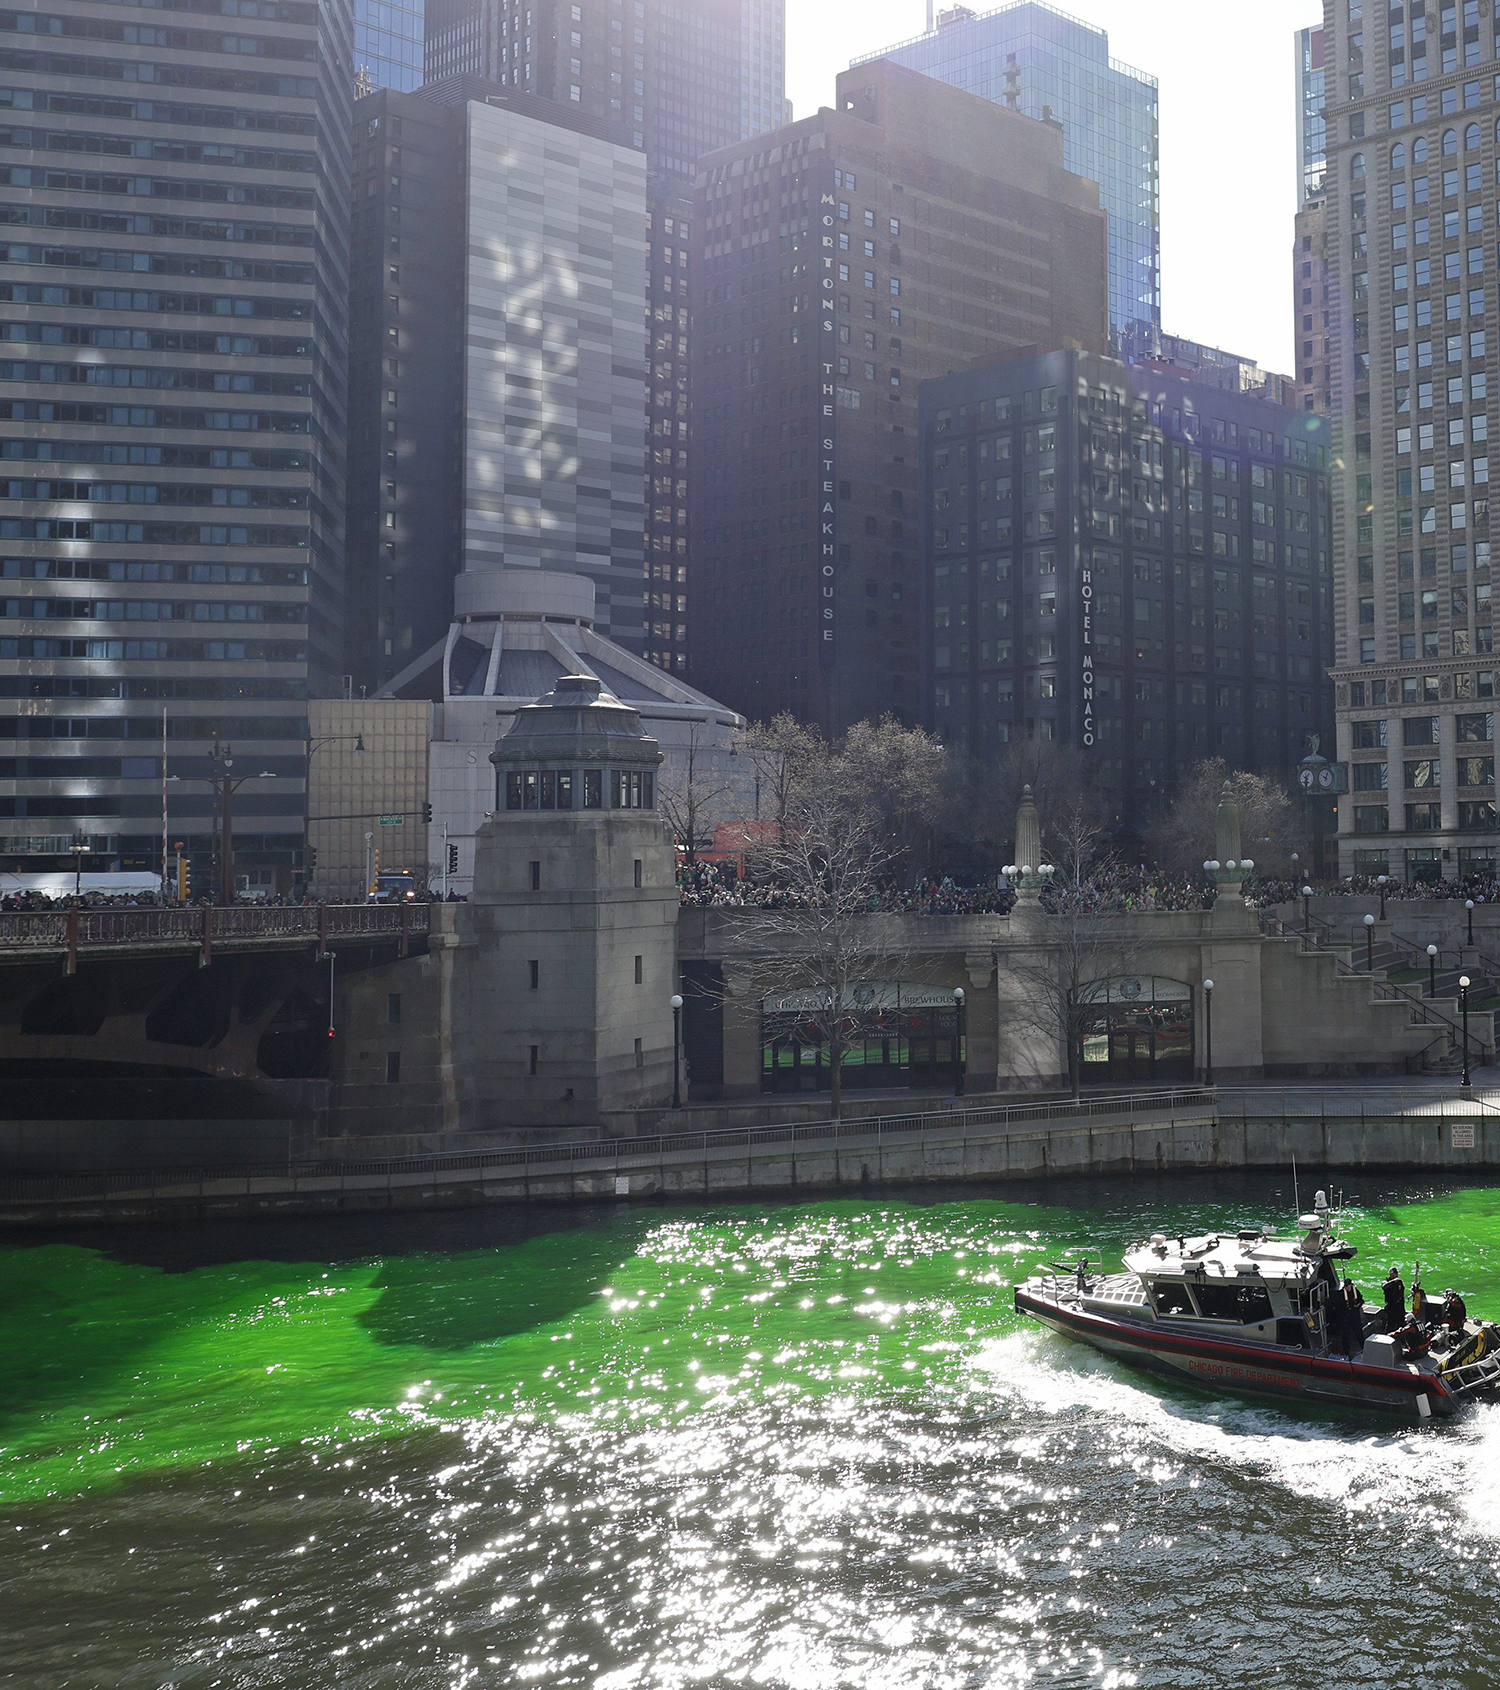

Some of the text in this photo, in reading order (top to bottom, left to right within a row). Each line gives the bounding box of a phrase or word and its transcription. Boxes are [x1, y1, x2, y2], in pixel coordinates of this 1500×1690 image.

[821, 193, 835, 641] MORTONS THE STEAKHOUSE
[1081, 570, 1094, 746] HOTEL MONACO
[904, 995, 962, 1004] BREWHOUS
[1188, 1360, 1302, 1387] CHICAGO FIRE DEPARTMENT
